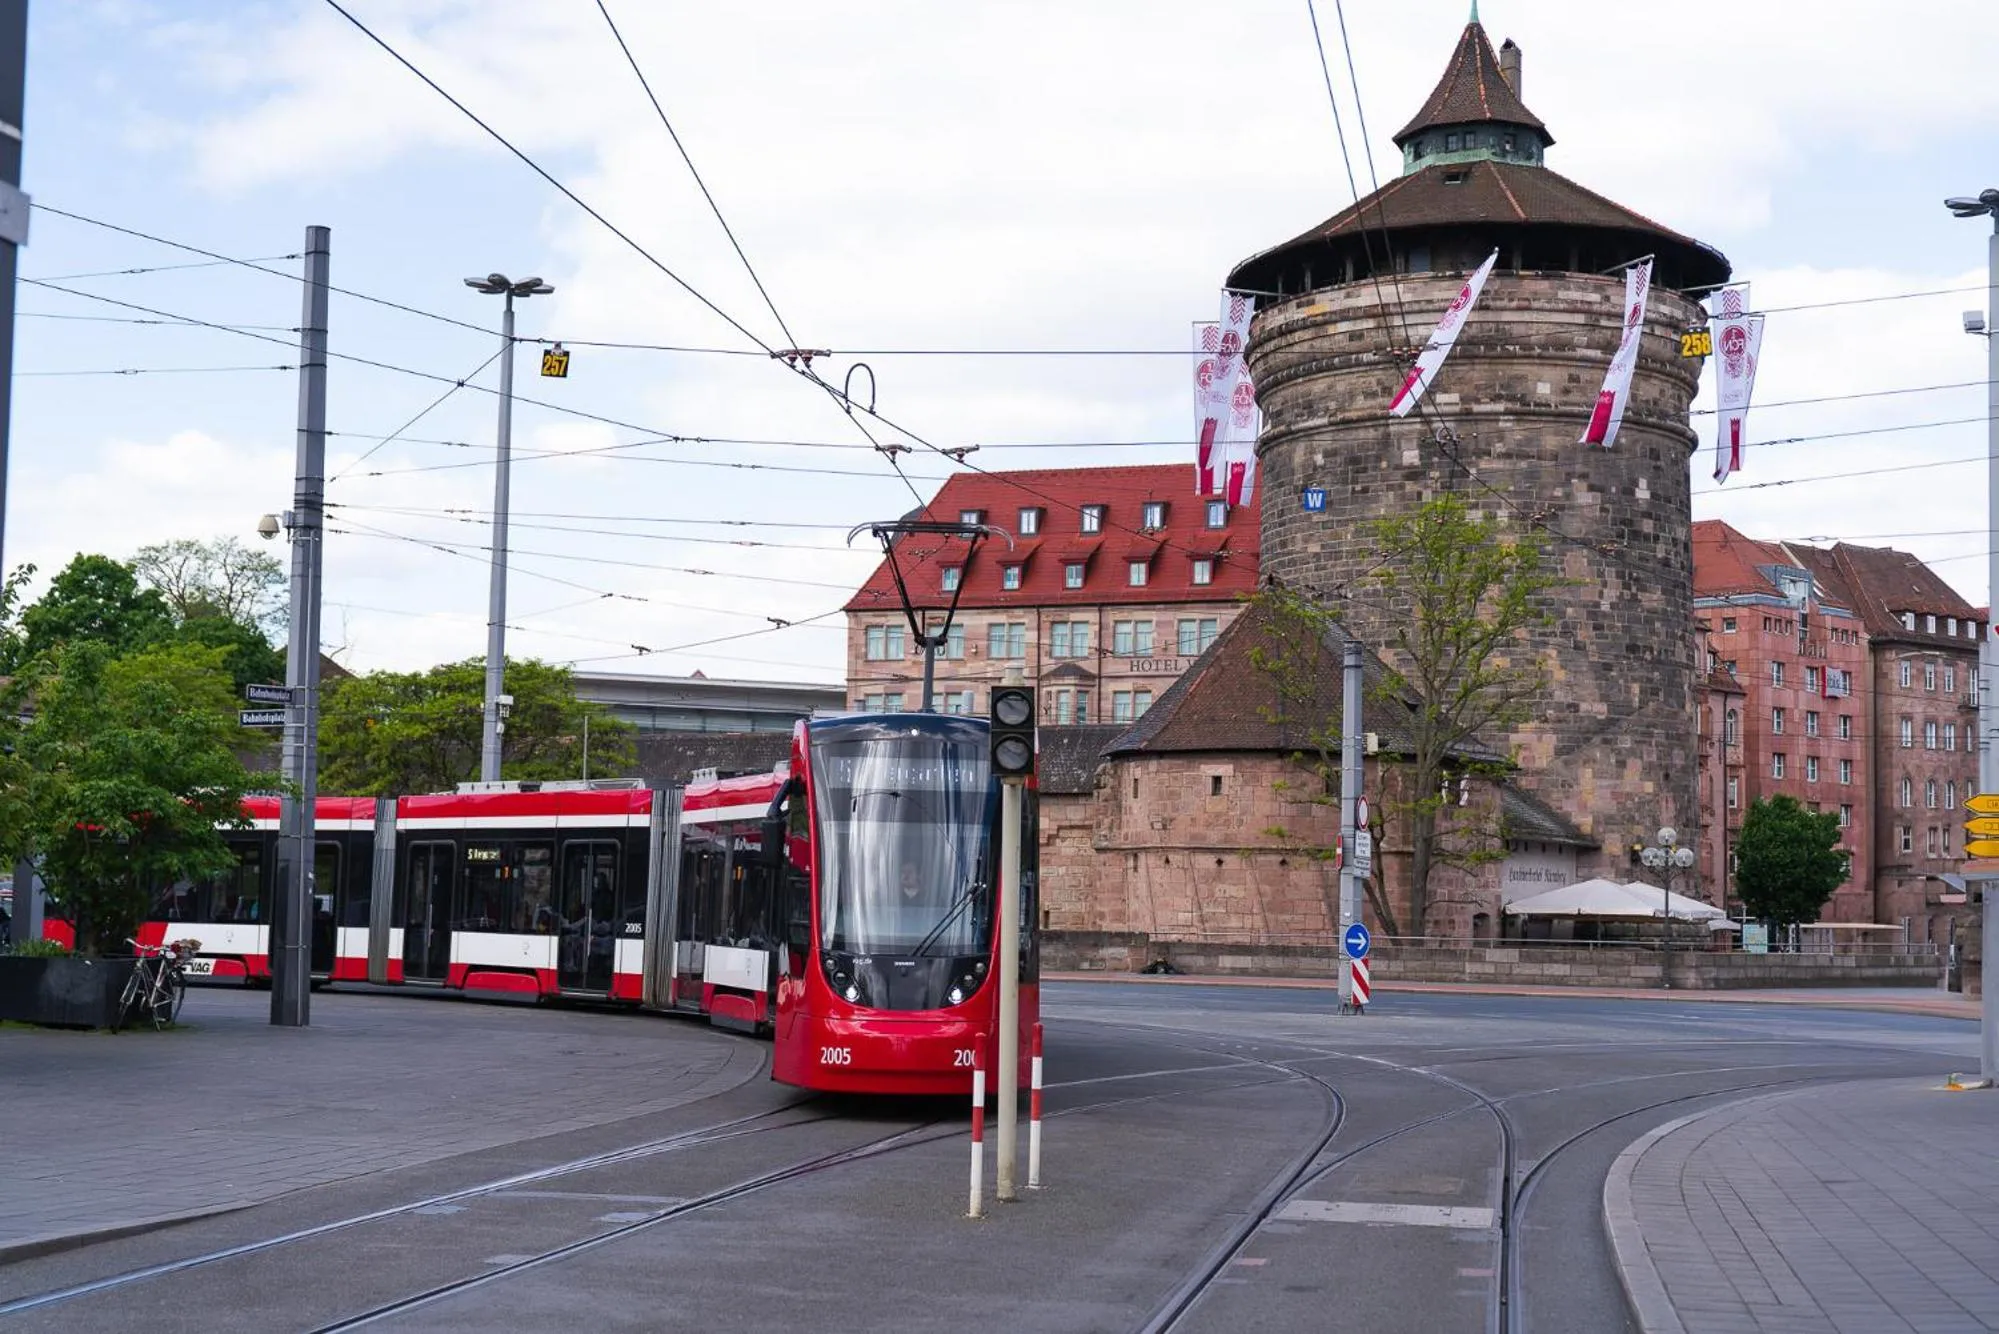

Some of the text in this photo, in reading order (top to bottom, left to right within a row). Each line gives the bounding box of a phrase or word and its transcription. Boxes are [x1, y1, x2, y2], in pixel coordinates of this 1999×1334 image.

[1682, 333, 1711, 357] 258
[543, 355, 568, 376] 257
[1307, 493, 1323, 508] W
[1130, 660, 1181, 672] HOTEL
[625, 922, 642, 933] 2005
[190, 962, 210, 973] VAG
[820, 1047, 851, 1065] 2005
